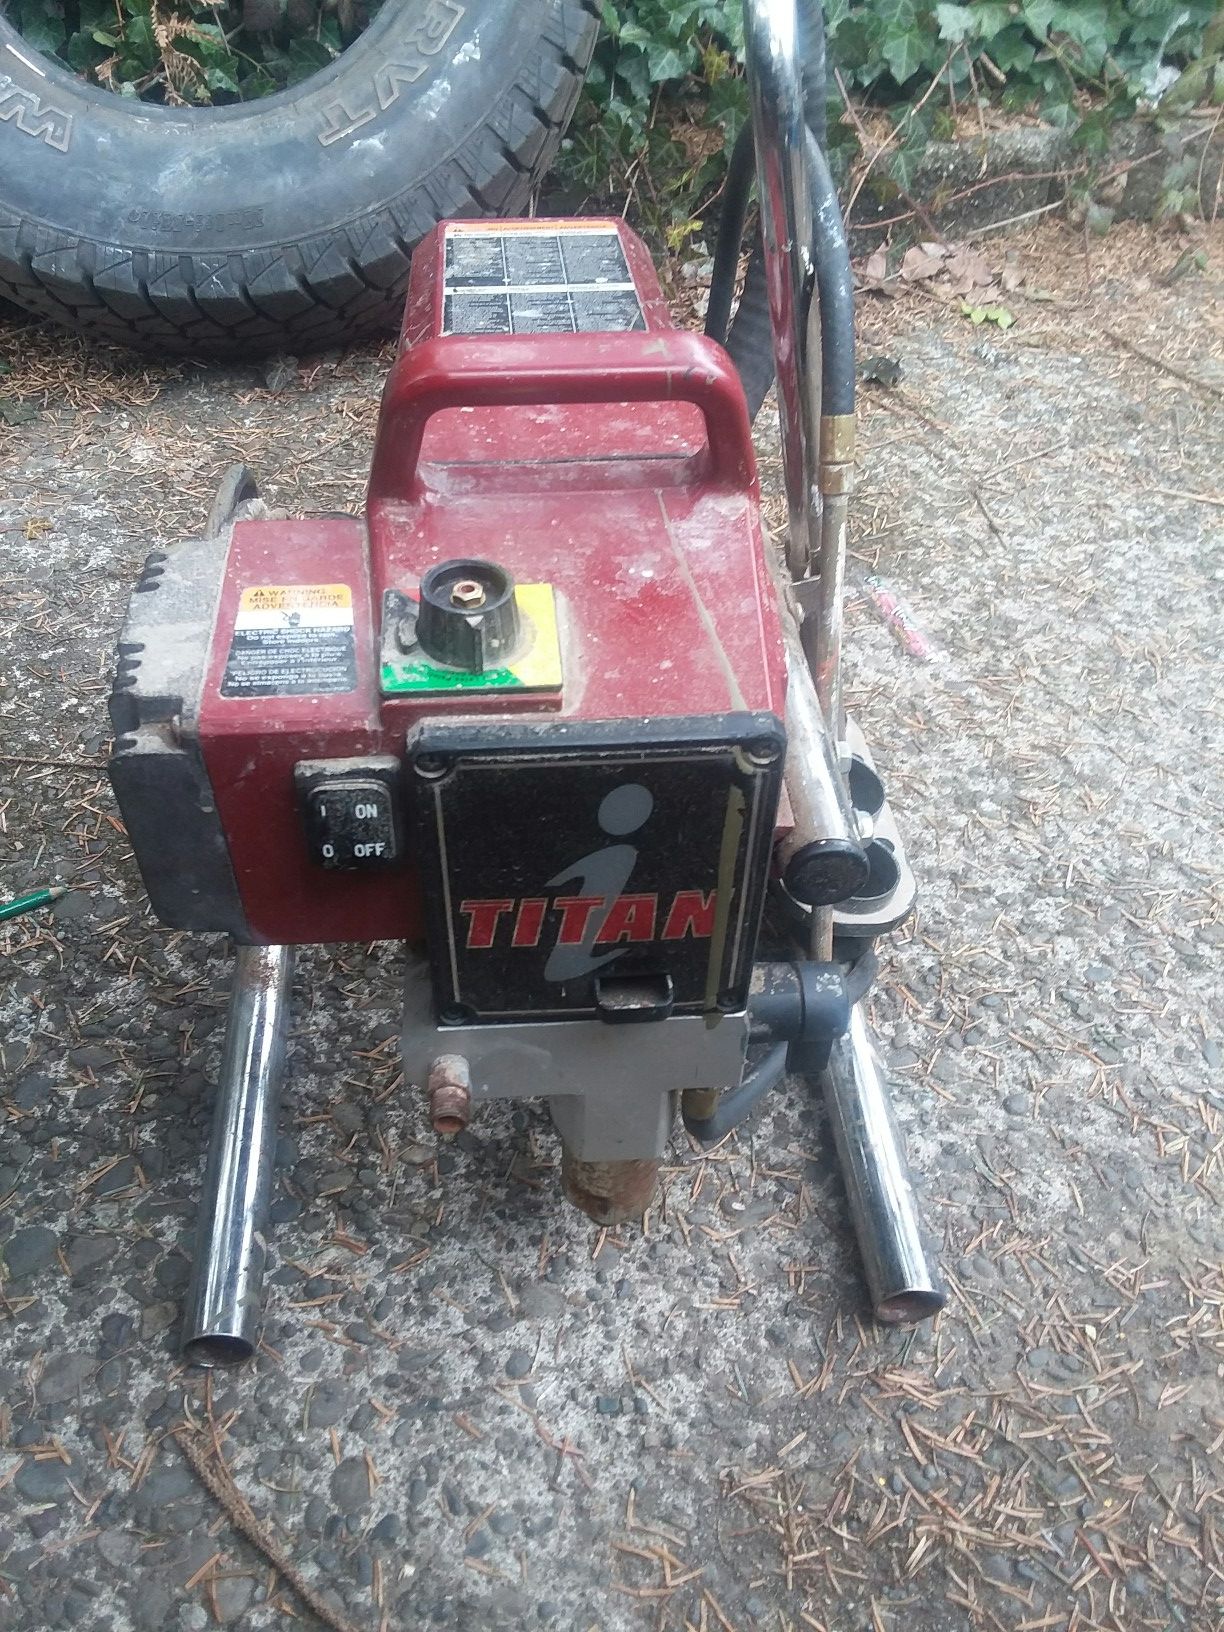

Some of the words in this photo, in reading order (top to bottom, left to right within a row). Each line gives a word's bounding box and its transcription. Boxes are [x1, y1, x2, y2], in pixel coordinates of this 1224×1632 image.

[234, 629, 279, 637] ELECTRIC
[235, 648, 266, 656] DANGER
[279, 647, 300, 655] CHOC
[354, 804, 378, 818] ON
[354, 843, 386, 858] OFF
[460, 889, 735, 949] TITAN
